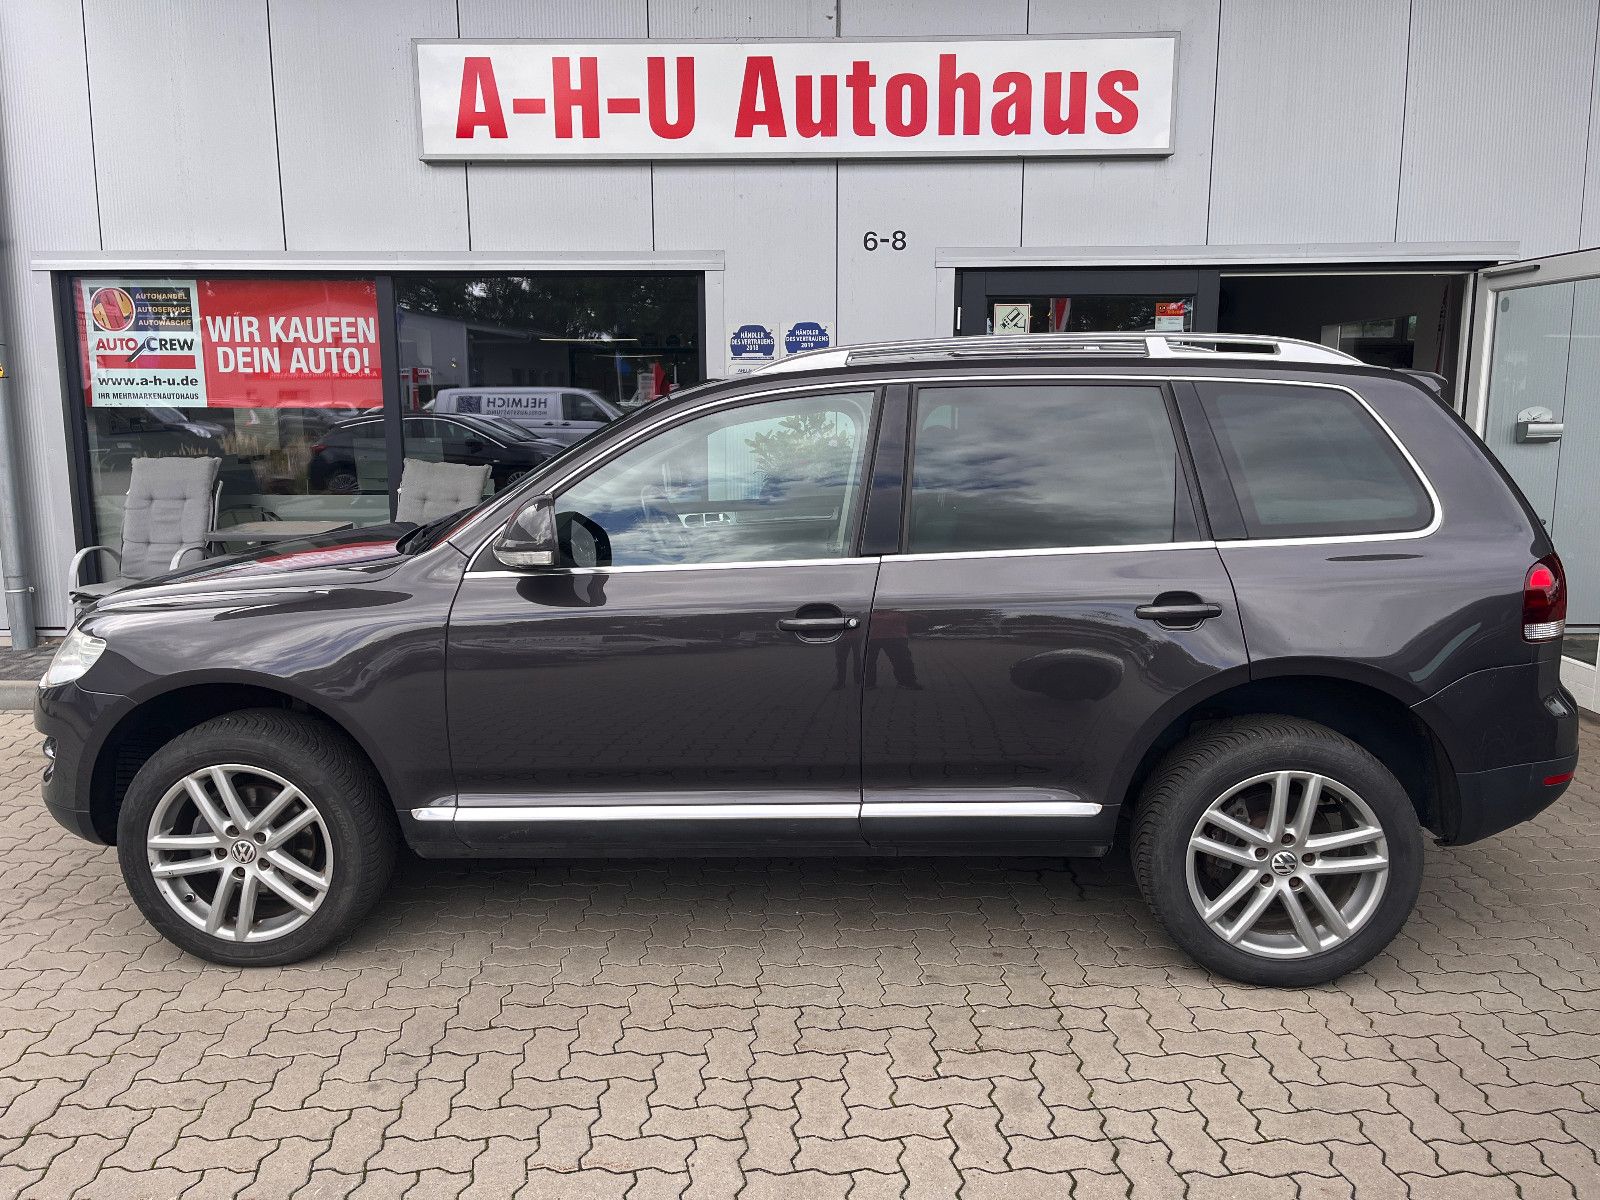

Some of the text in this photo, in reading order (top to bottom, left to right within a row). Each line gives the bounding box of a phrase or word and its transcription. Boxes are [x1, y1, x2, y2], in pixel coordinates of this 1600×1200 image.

[455, 53, 1139, 139] A-H-U Autohaus
[863, 230, 907, 251] 6-8
[205, 315, 376, 344] WIR KAUFEN
[741, 331, 765, 339] HÄNDLER
[96, 336, 195, 351] AUTO CREW
[216, 346, 370, 374] DEIN AUTO!
[97, 375, 199, 386] www.a-h-u.de
[112, 392, 199, 400] MEHRMARKENAUTOHAUS
